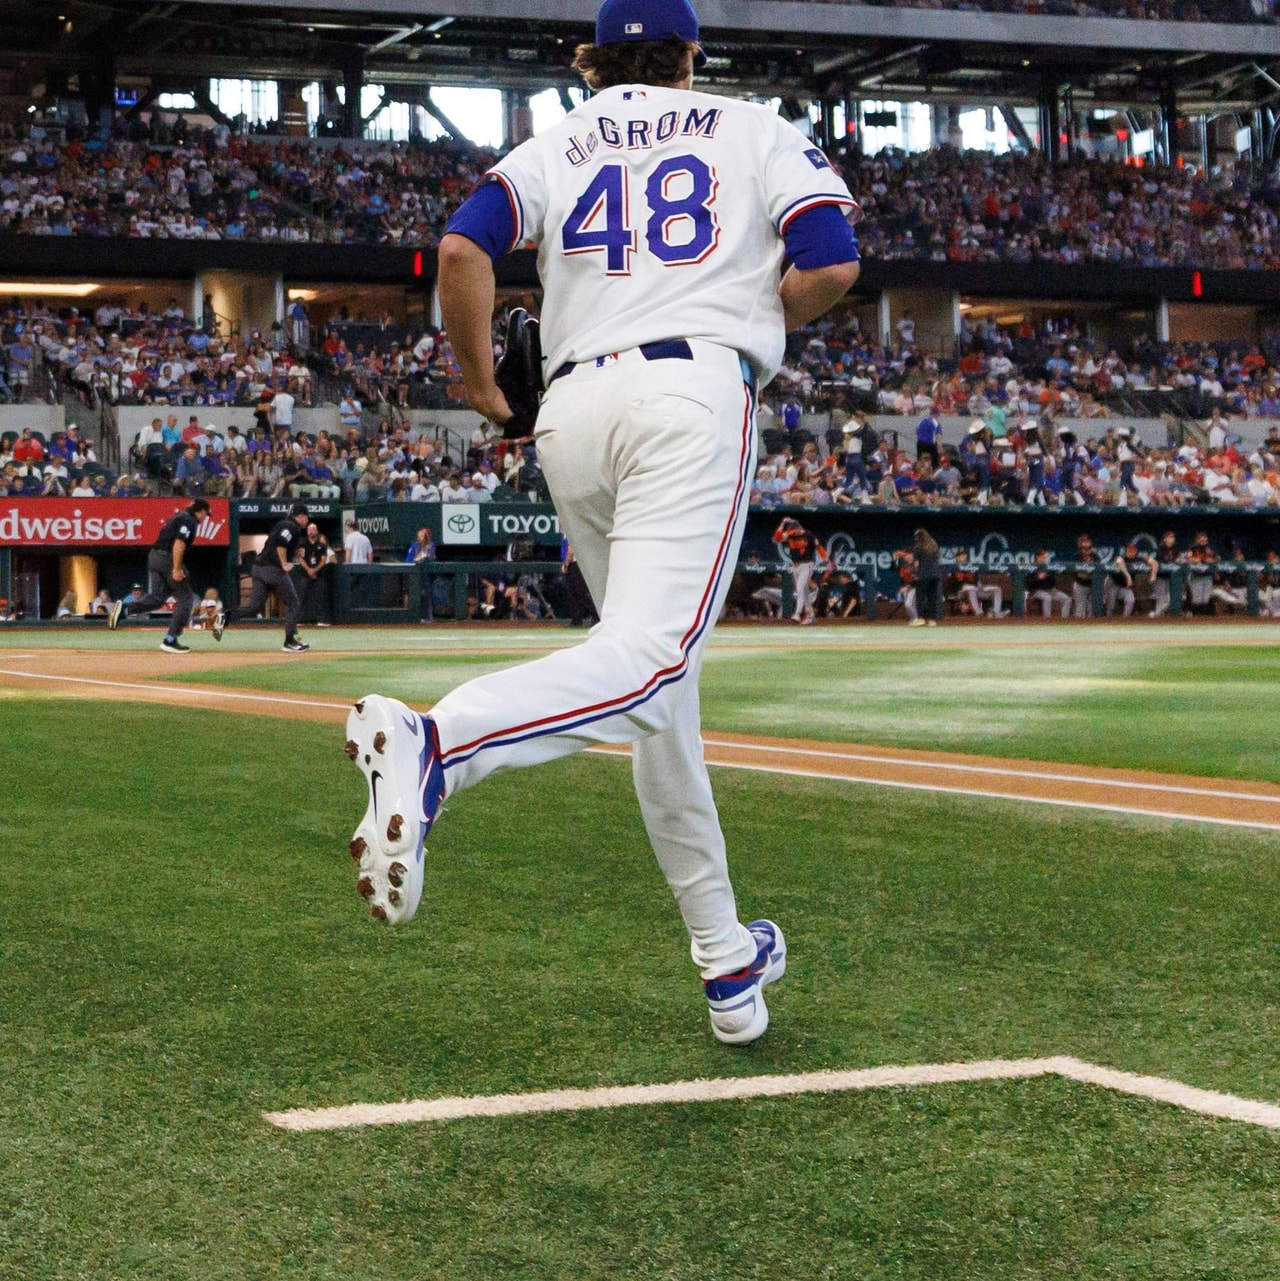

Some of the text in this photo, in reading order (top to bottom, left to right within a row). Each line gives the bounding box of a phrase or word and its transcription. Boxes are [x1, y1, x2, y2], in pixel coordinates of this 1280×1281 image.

[565, 108, 723, 168] deGROM
[562, 153, 722, 277] 48
[357, 516, 390, 534] TOYOTA
[488, 514, 560, 534] TOYOT
